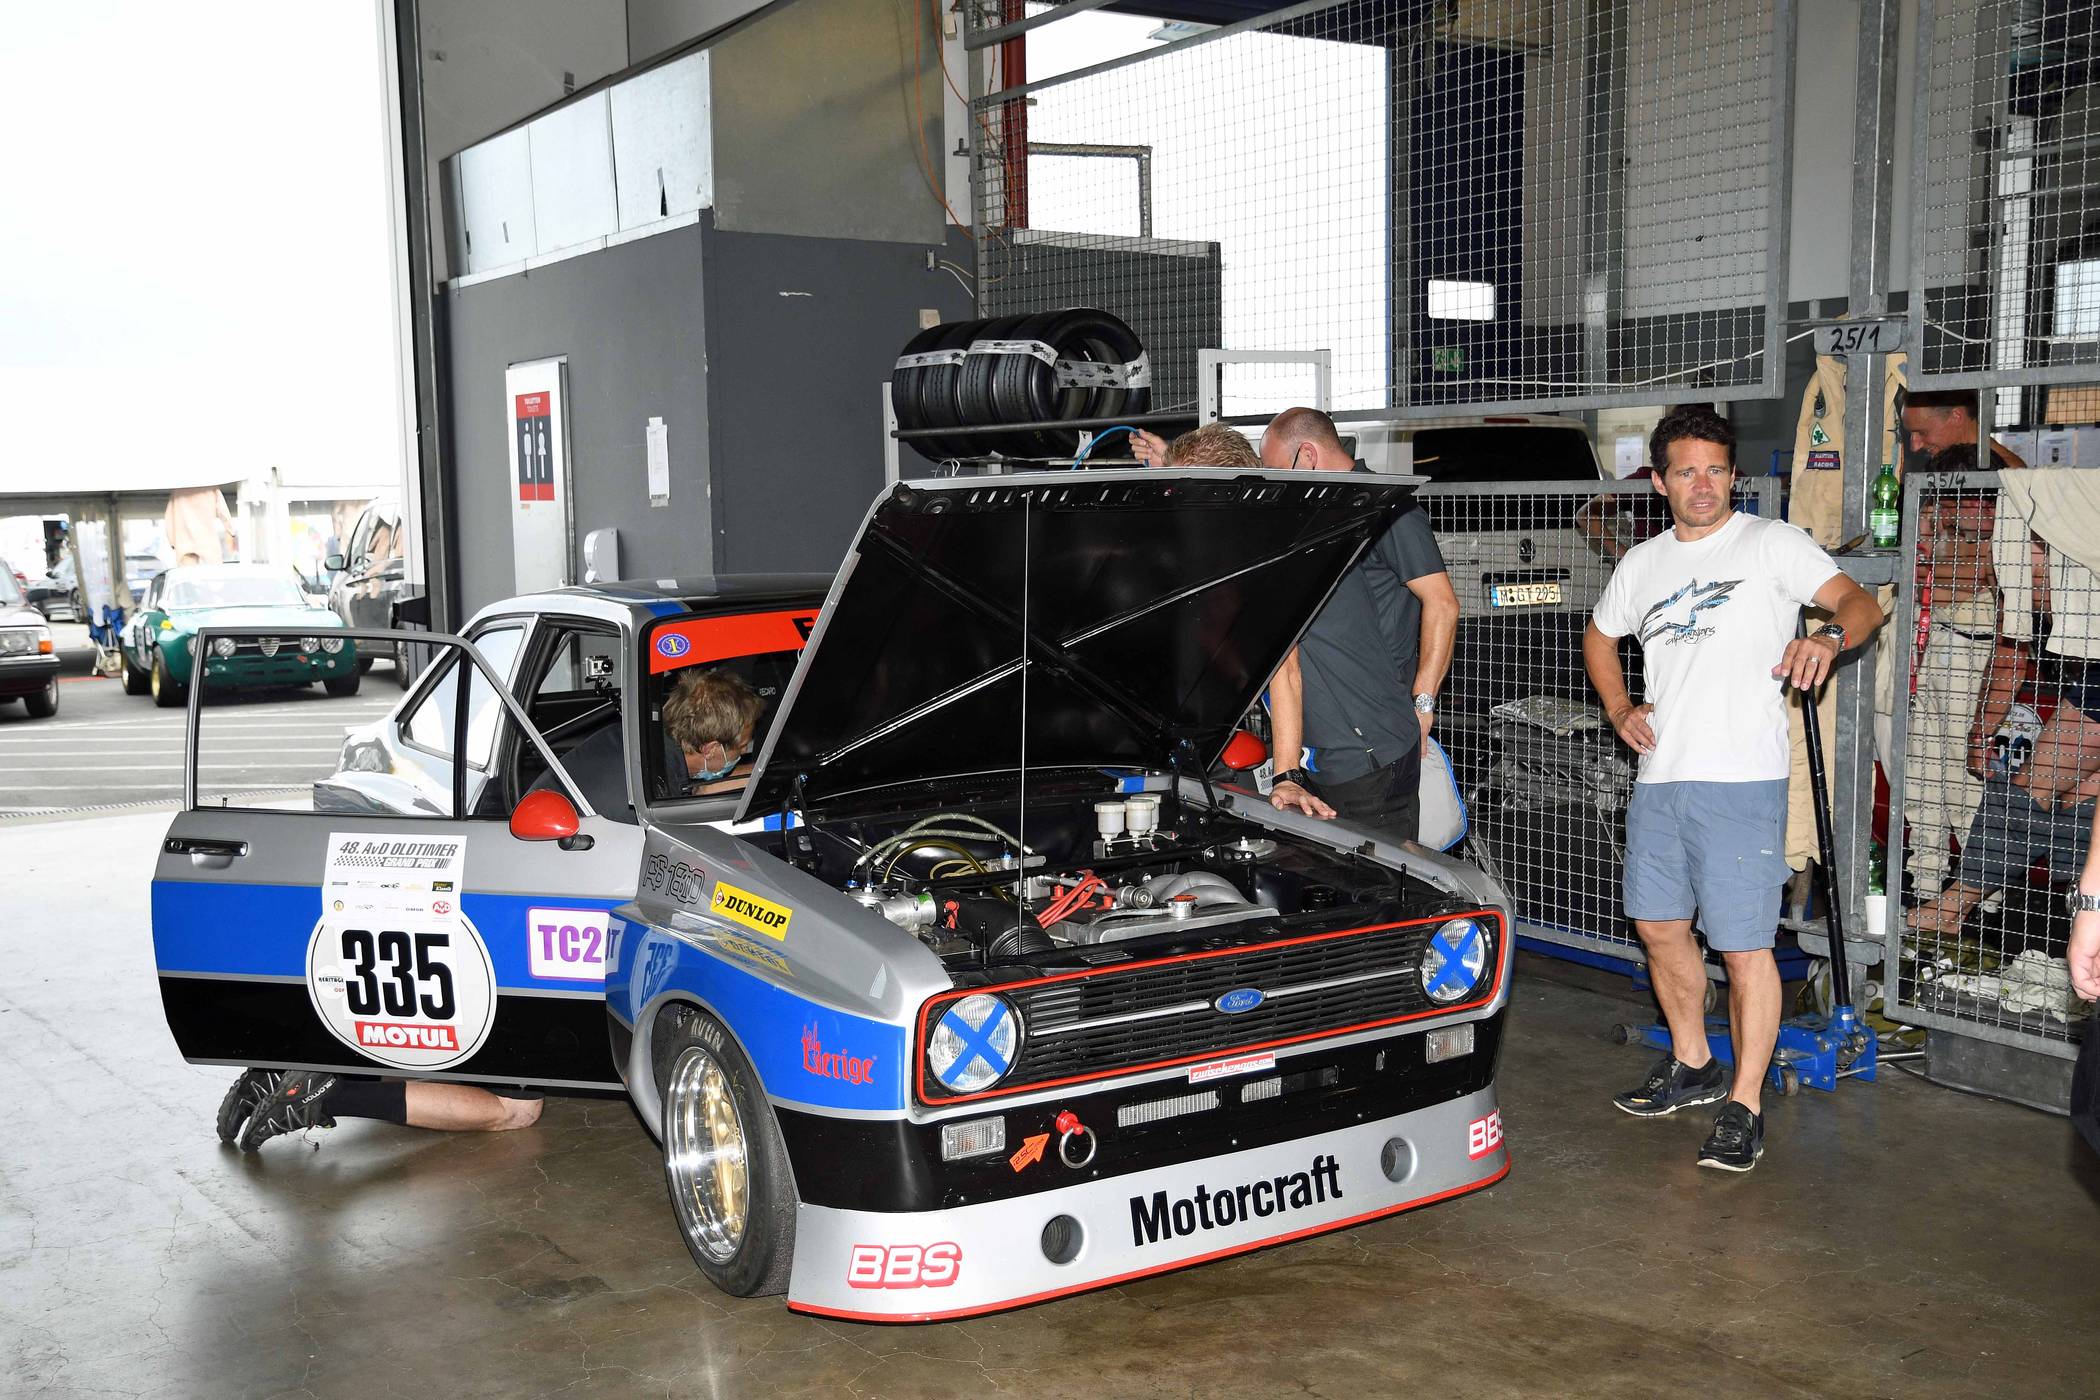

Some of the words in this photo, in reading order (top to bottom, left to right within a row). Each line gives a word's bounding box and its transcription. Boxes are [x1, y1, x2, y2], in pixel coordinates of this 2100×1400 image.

[1830, 324, 1879, 351] 25/1
[1926, 472, 1967, 489] 25/4
[339, 841, 360, 855] 48.
[361, 842, 389, 855] AvD
[390, 842, 459, 857] OLDTIMER
[382, 857, 415, 868] GRAND
[416, 858, 438, 868] PRIX
[642, 854, 669, 891] RS
[724, 895, 787, 928] DUNLOP
[537, 924, 602, 964] TC2
[341, 929, 456, 1020] 335
[363, 1024, 454, 1047] MOTUL
[1129, 1155, 1343, 1247] Motorcraft
[847, 1241, 962, 1289] BBS
